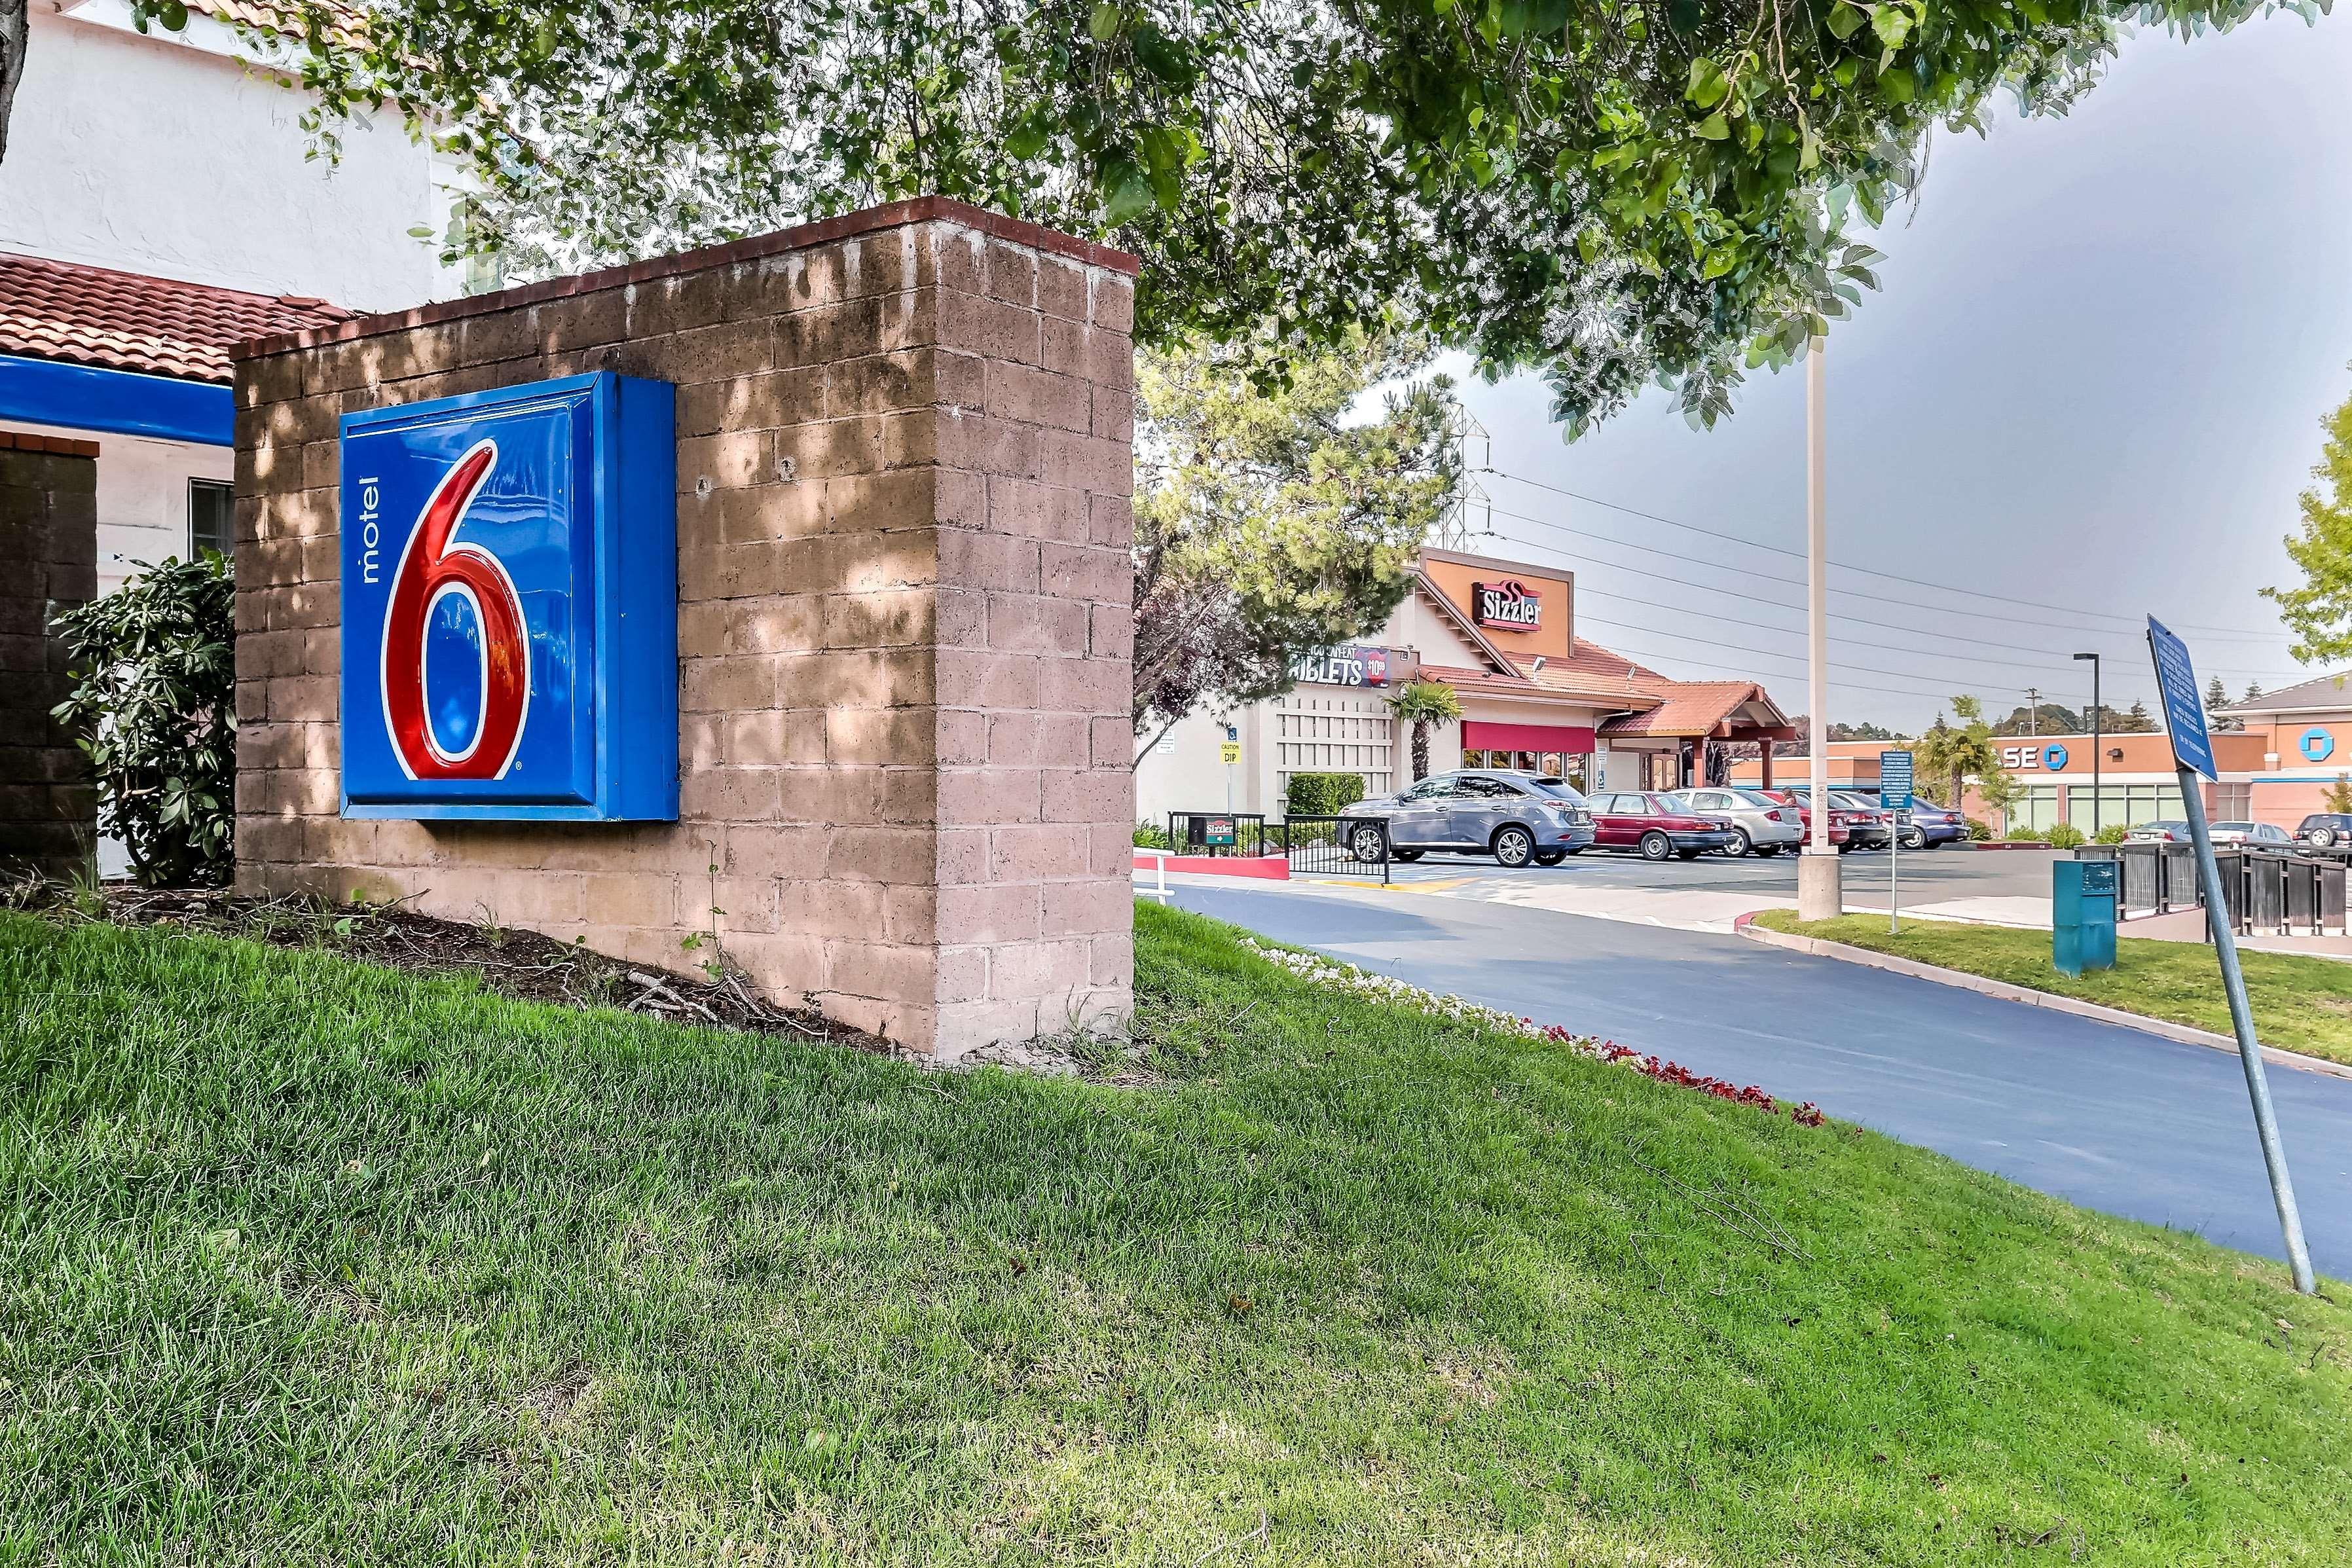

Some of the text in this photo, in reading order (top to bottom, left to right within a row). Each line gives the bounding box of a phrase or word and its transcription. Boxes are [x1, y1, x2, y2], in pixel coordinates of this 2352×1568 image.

[358, 477, 378, 583] motel
[380, 438, 532, 780] 6
[1483, 591, 1542, 624] Sizzler
[1224, 753, 1236, 762] DIP
[1206, 824, 1233, 833] Sizzler
